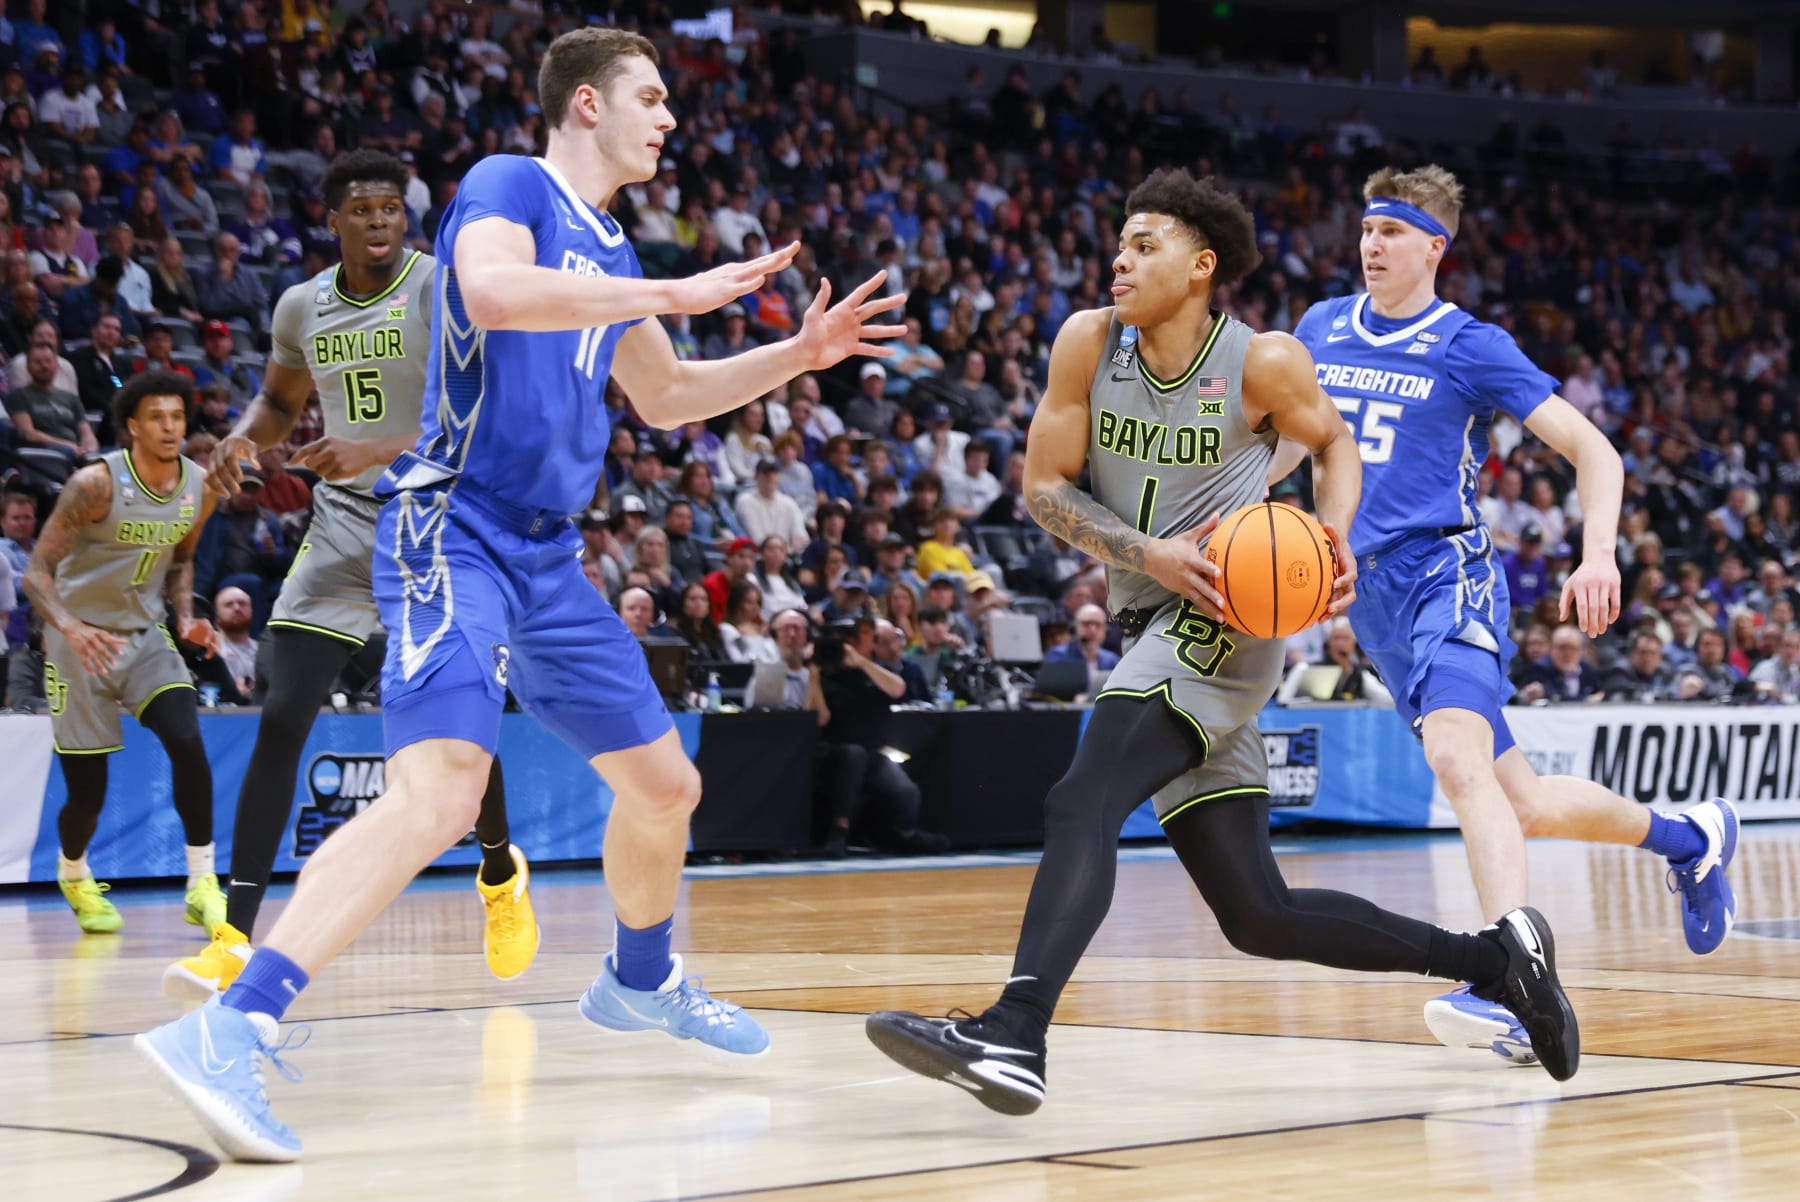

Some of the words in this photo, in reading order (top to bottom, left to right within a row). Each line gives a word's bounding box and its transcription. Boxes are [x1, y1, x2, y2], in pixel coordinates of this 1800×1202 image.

[313, 326, 406, 369] BAYLOR
[1112, 348, 1133, 368] ONE
[342, 368, 386, 424] 15
[1315, 363, 1435, 400] CREIGHTON
[1197, 399, 1226, 416] XII
[1098, 408, 1222, 466] BAYLOR
[1136, 475, 1159, 537] 1
[339, 761, 385, 799] MA
[1267, 766, 1319, 796] NESS
[1591, 724, 1800, 803] MOUNTAI
